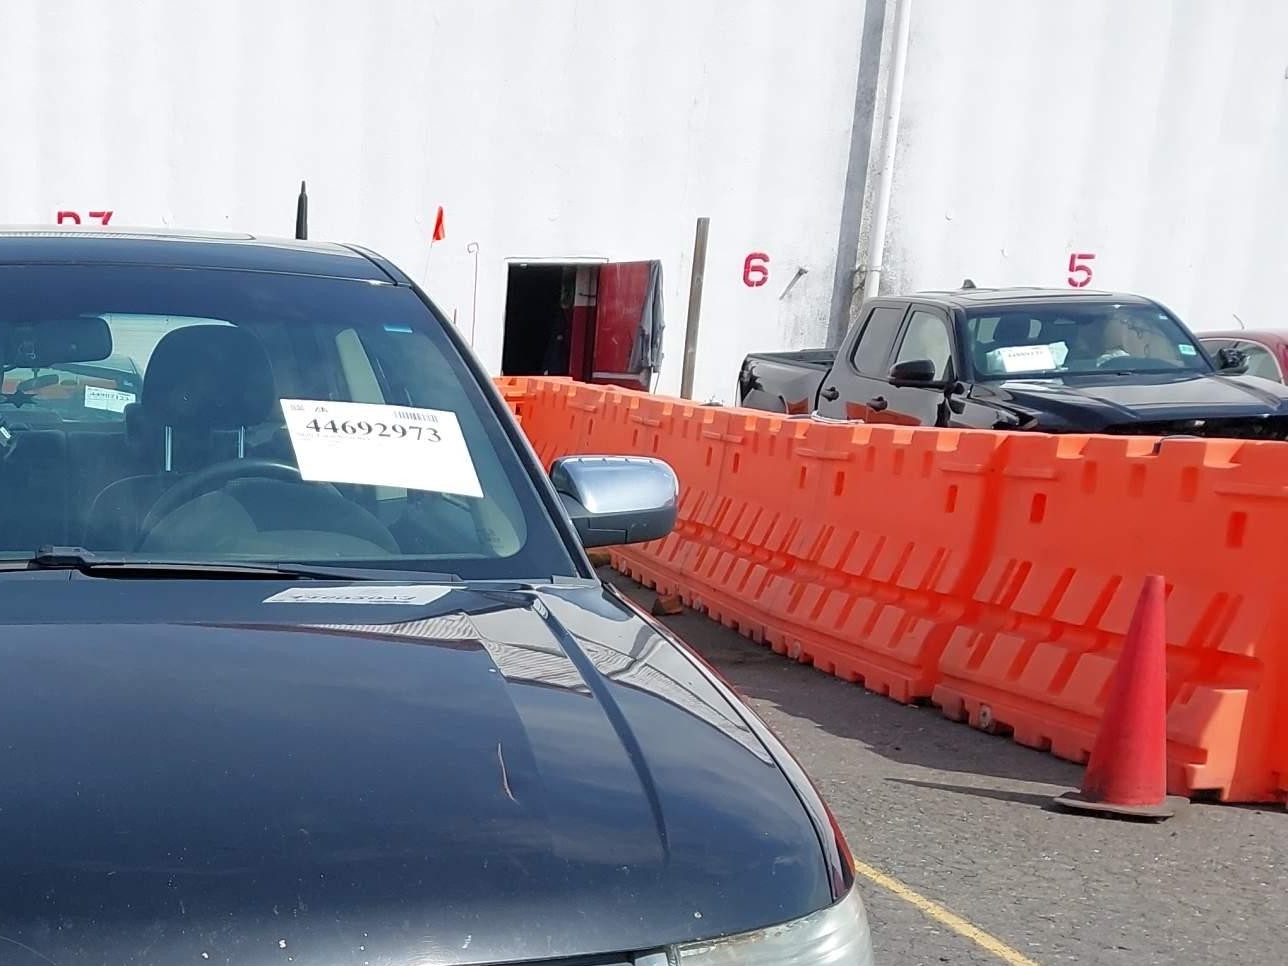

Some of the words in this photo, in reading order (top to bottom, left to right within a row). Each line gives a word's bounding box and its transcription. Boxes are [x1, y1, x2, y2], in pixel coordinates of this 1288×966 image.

[743, 252, 770, 287] 6
[1068, 253, 1096, 287] 5
[305, 418, 443, 443] 44692973
